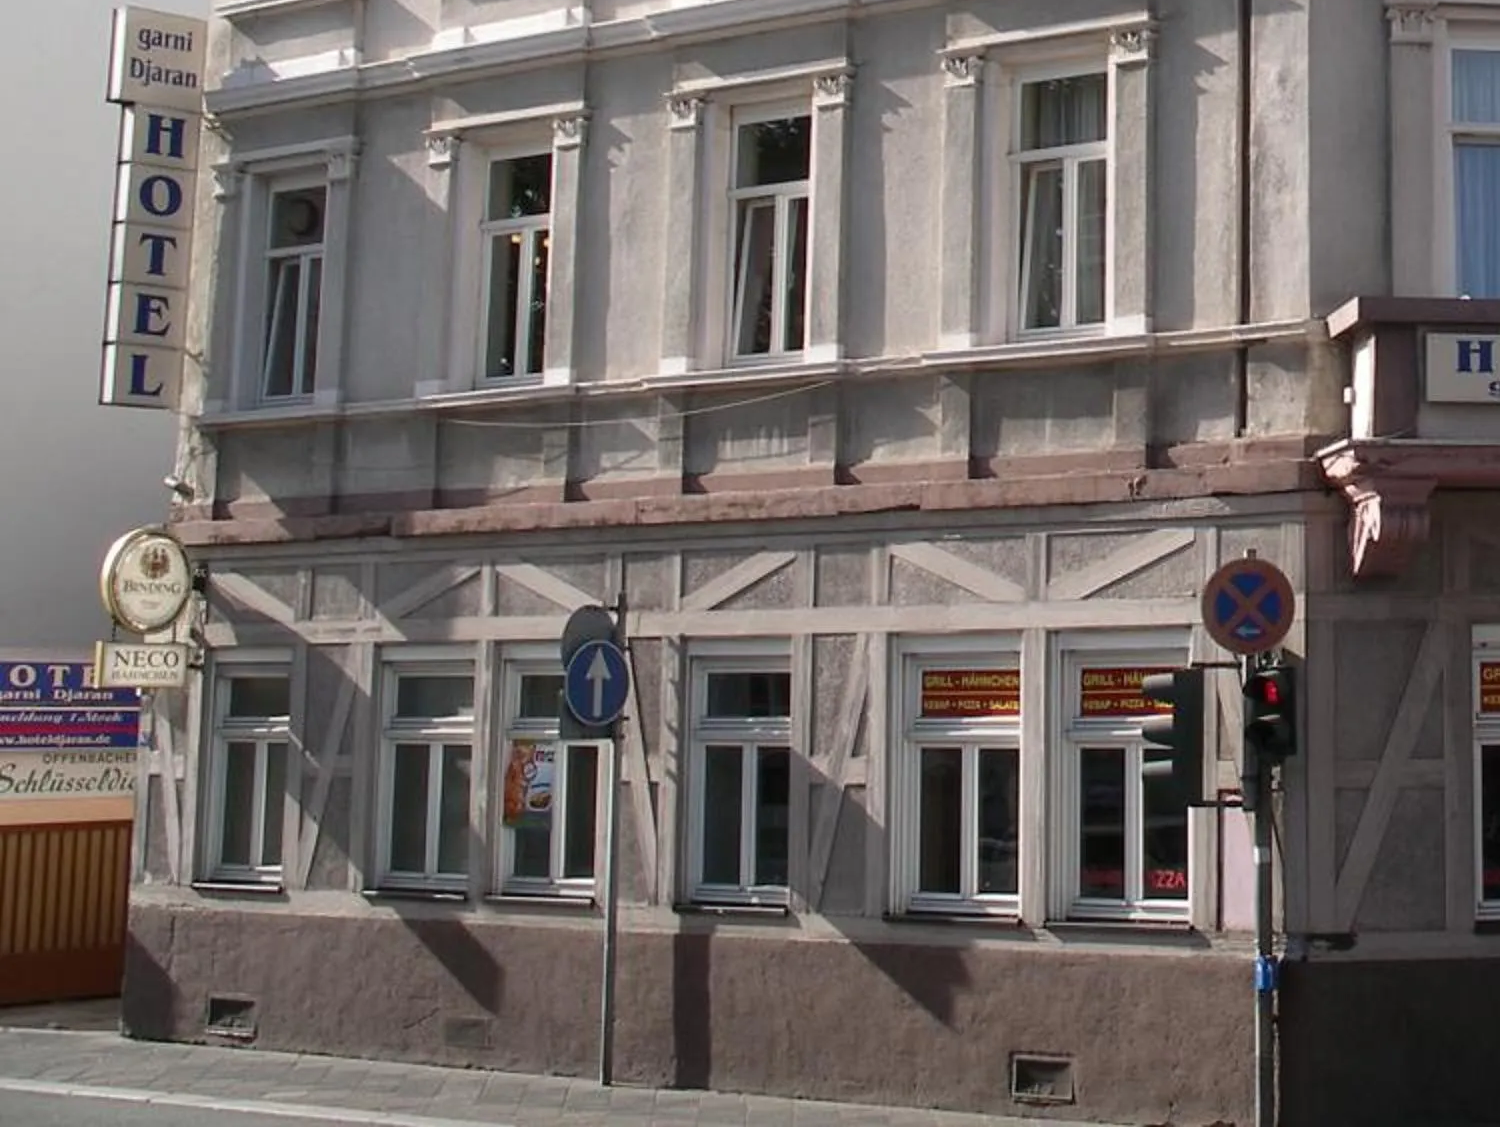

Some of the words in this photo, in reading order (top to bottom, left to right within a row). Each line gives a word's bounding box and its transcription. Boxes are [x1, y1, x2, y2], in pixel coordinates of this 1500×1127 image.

[138, 28, 193, 51] garni
[130, 57, 197, 88] Djaran
[128, 114, 186, 397] HOTEL
[122, 579, 181, 593] BINDING
[113, 649, 179, 668] NECO
[0, 689, 41, 701] arni
